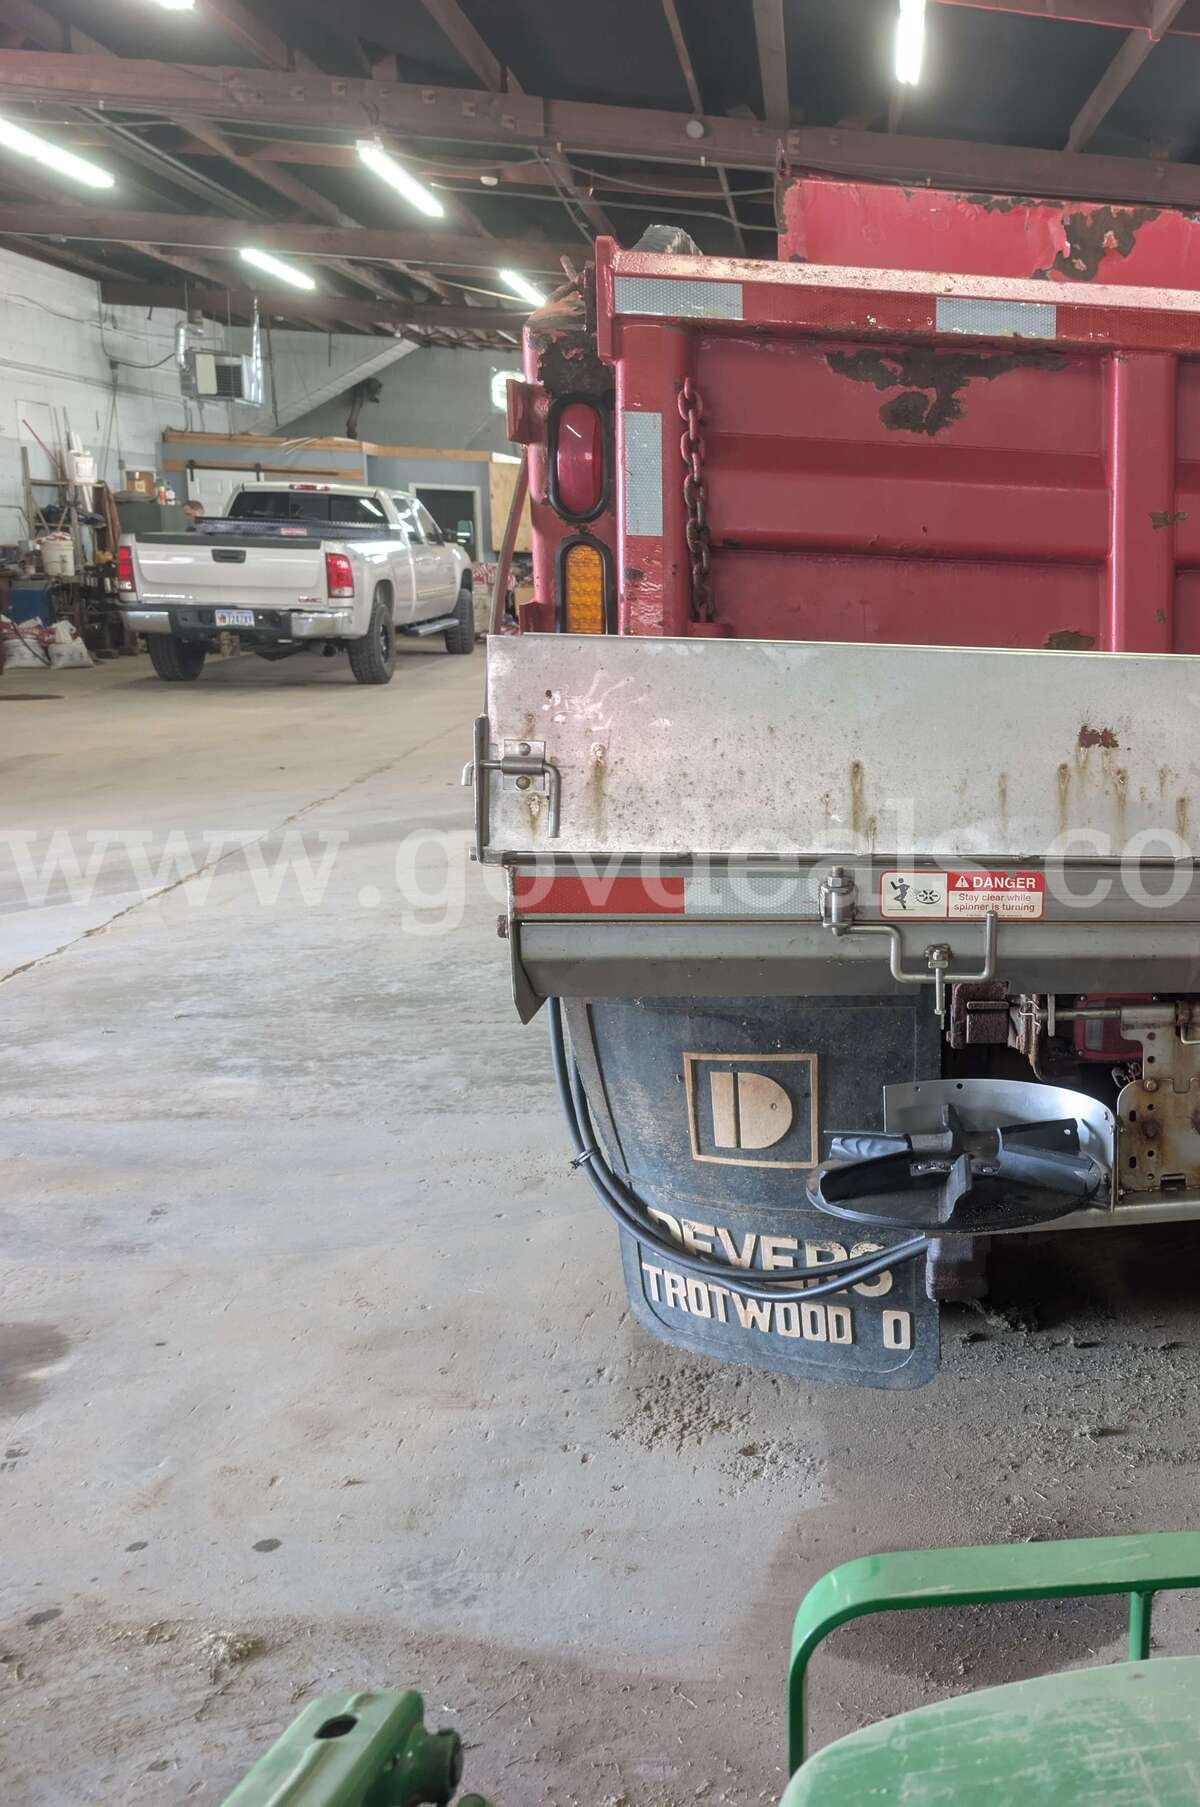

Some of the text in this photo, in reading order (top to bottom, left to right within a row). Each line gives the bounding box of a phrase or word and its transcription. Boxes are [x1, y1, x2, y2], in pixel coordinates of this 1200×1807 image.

[972, 876, 1036, 889] DANGER
[958, 893, 1032, 902] Stay clear while
[953, 903, 988, 913] spinner
[1002, 903, 1035, 913] turning
[641, 1263, 853, 1345] TROTWOOD
